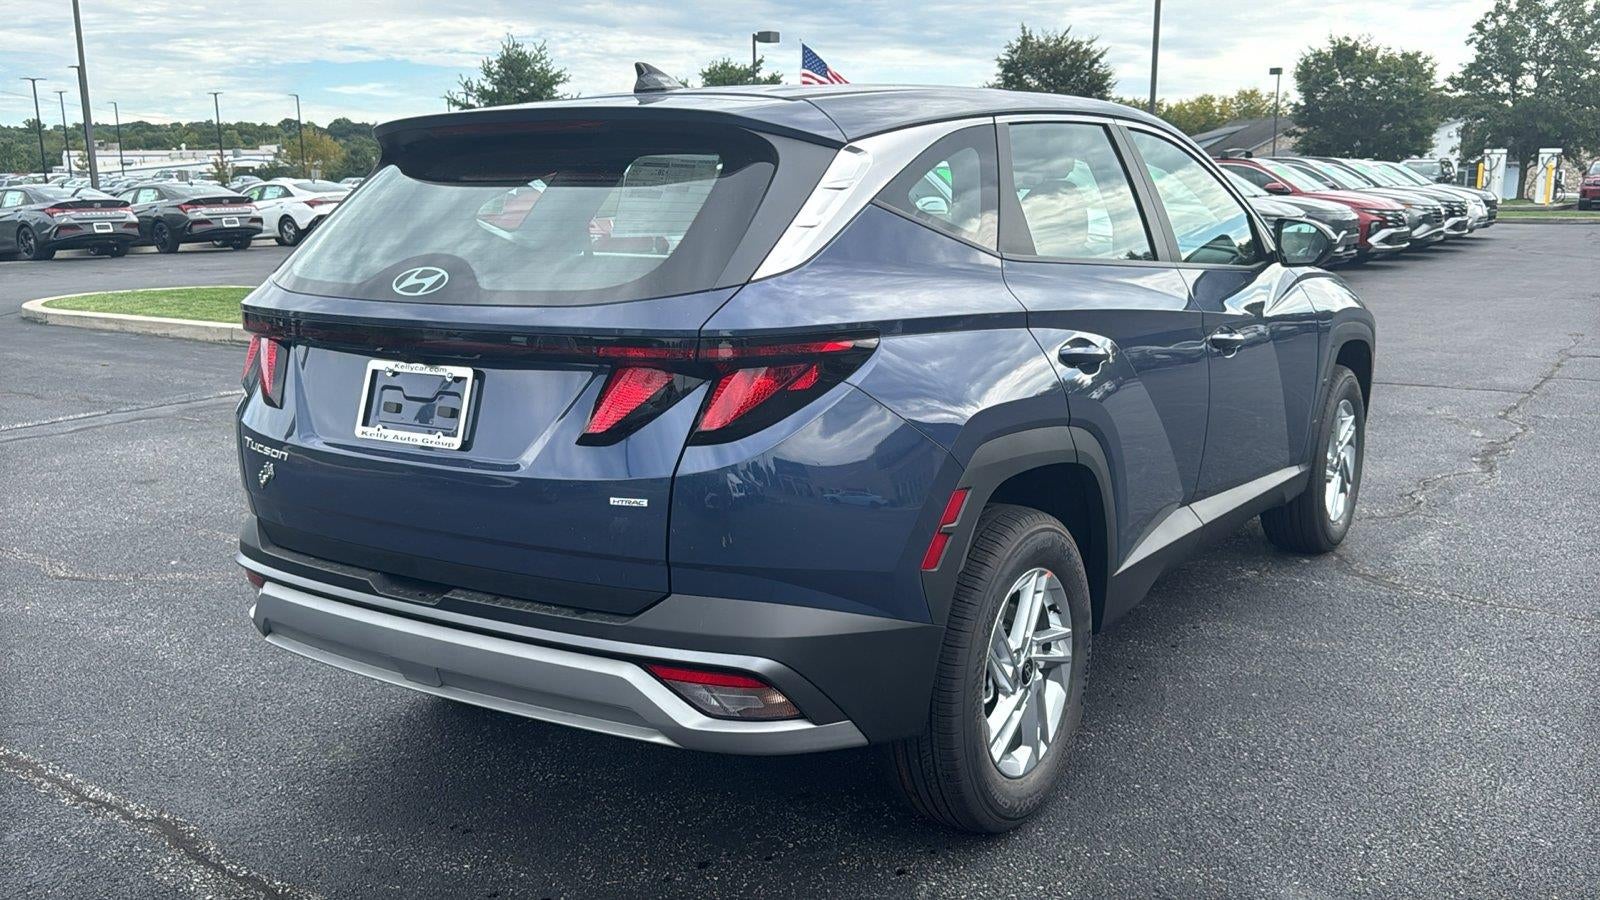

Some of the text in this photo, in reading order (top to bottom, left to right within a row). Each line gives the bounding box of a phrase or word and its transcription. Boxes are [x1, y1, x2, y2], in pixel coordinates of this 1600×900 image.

[394, 362, 447, 373] Kellycar.com
[361, 430, 455, 447] Kelly Auto Group
[244, 435, 288, 461] Tucson
